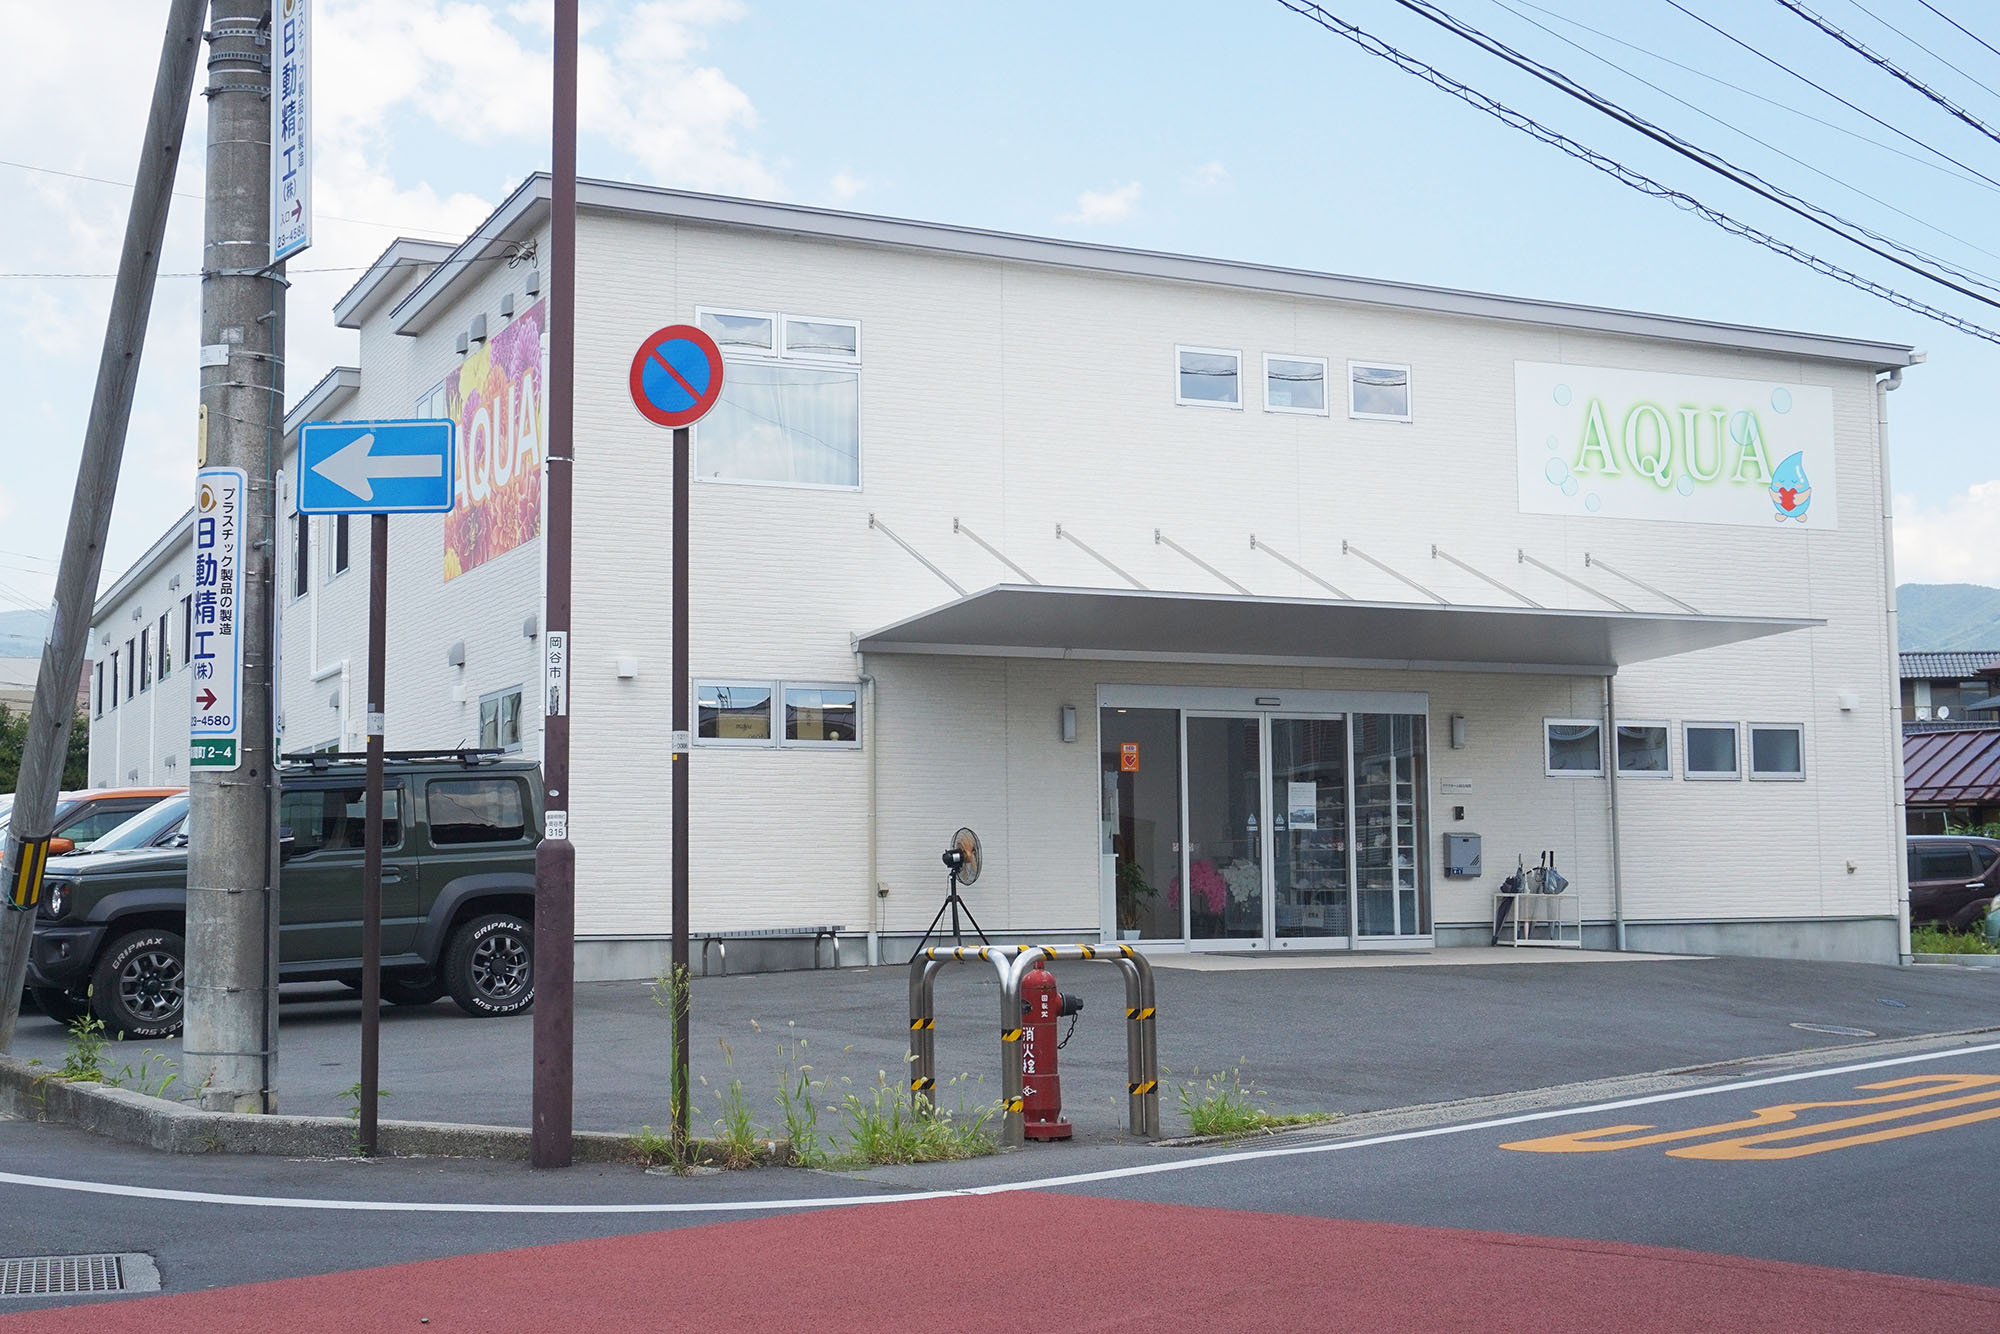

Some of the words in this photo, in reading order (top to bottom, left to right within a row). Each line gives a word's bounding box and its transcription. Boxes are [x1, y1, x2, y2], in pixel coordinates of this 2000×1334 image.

[277, 223, 305, 248] 23-4580
[449, 374, 540, 516] AQUA
[1574, 399, 1774, 488] AQUA
[219, 487, 235, 636] プラスチック製品の製造
[549, 636, 562, 679] 岡谷市
[549, 828, 563, 837] 315
[473, 921, 523, 940] GRIPMAX
[112, 937, 163, 970] GRIPMAX
[472, 997, 493, 1011] SUV
[501, 1002, 519, 1012] ICE
[519, 986, 535, 1007] RIP
[492, 1004, 501, 1012] X
[133, 1027, 159, 1036] SUV
[160, 1027, 167, 1035] X
[1022, 1026, 1036, 1074] 消火栓
